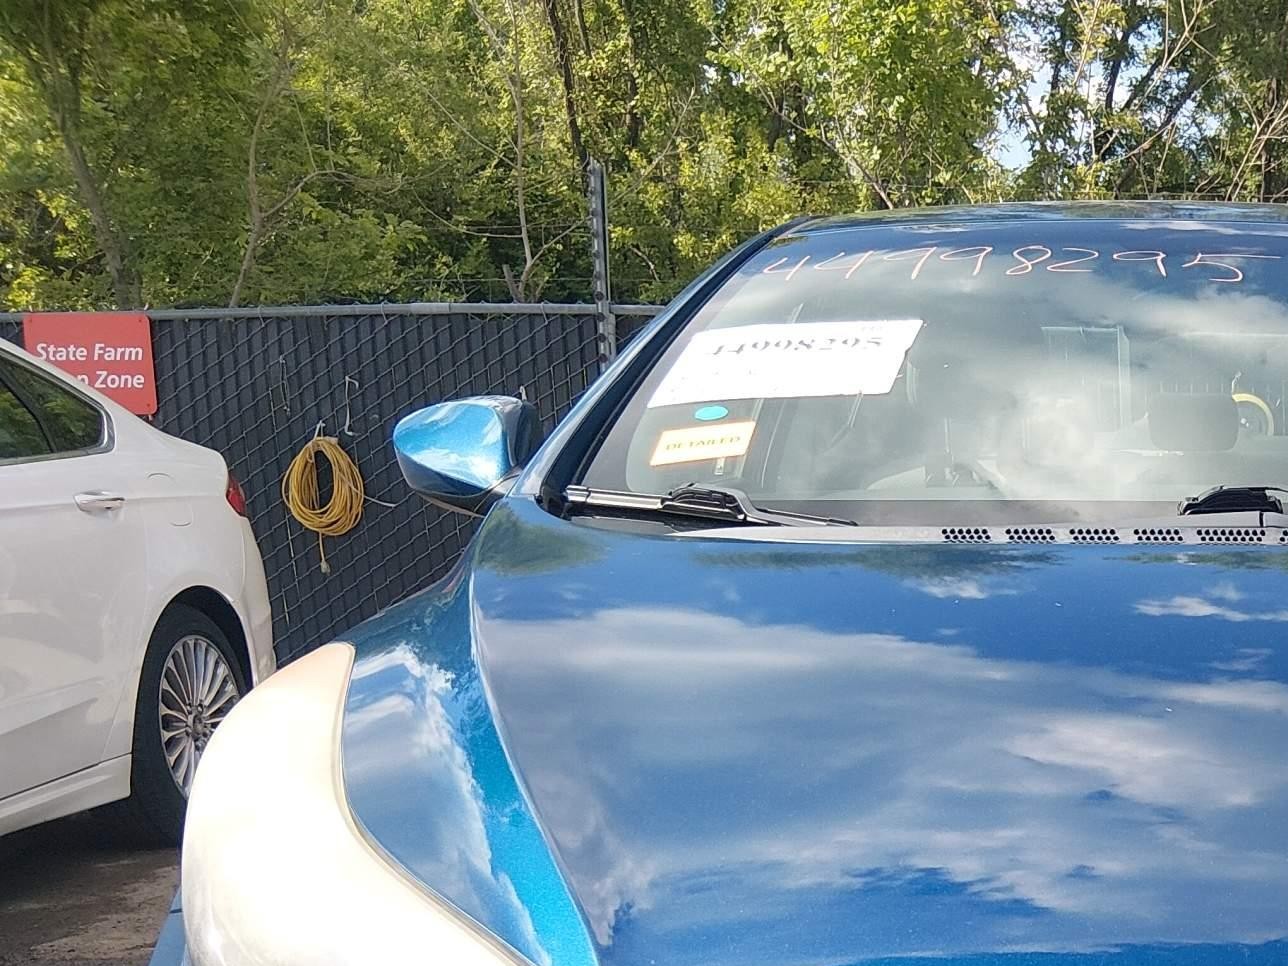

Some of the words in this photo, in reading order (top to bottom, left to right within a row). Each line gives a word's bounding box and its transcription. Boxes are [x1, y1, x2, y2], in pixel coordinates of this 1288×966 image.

[763, 245, 1281, 282] 44998295
[36, 343, 87, 361] State
[94, 343, 143, 361] Farm
[94, 370, 145, 388] Zone
